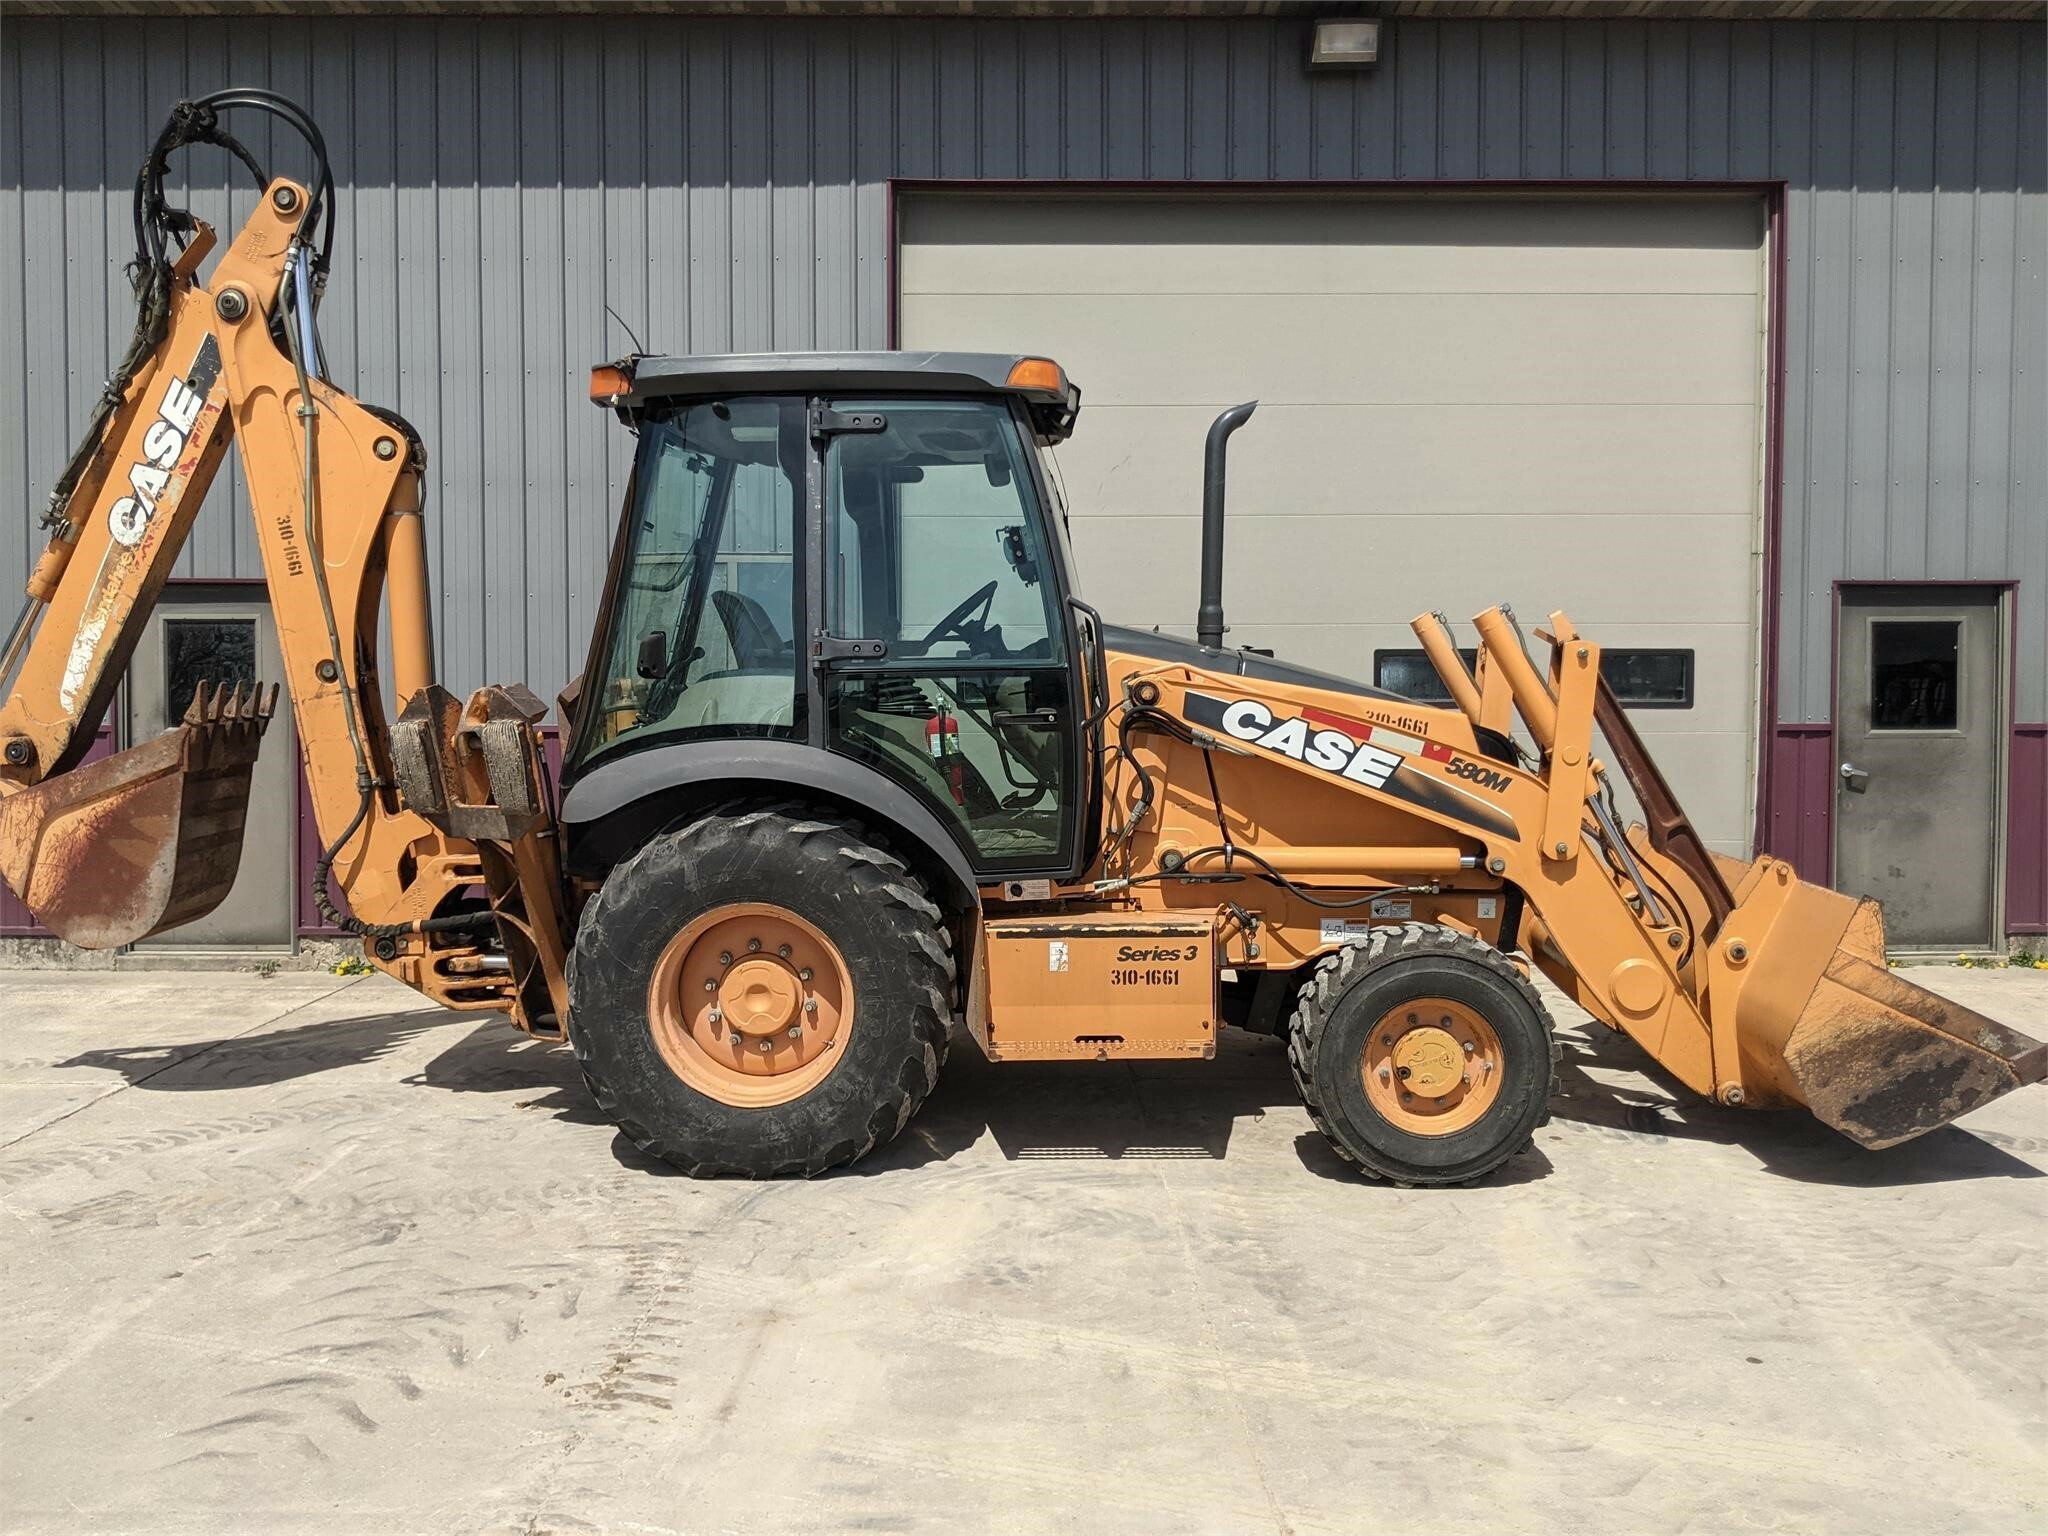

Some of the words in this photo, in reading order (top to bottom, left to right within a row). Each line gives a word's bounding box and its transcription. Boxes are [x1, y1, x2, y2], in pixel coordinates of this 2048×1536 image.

[107, 375, 204, 546] CASE
[276, 517, 303, 577] 310-1661
[1220, 698, 1405, 790] CASE
[1444, 756, 1513, 794] 580M
[1110, 969, 1179, 985] 310-1661
[1116, 944, 1181, 963] Series
[1183, 945, 1198, 962] 3
